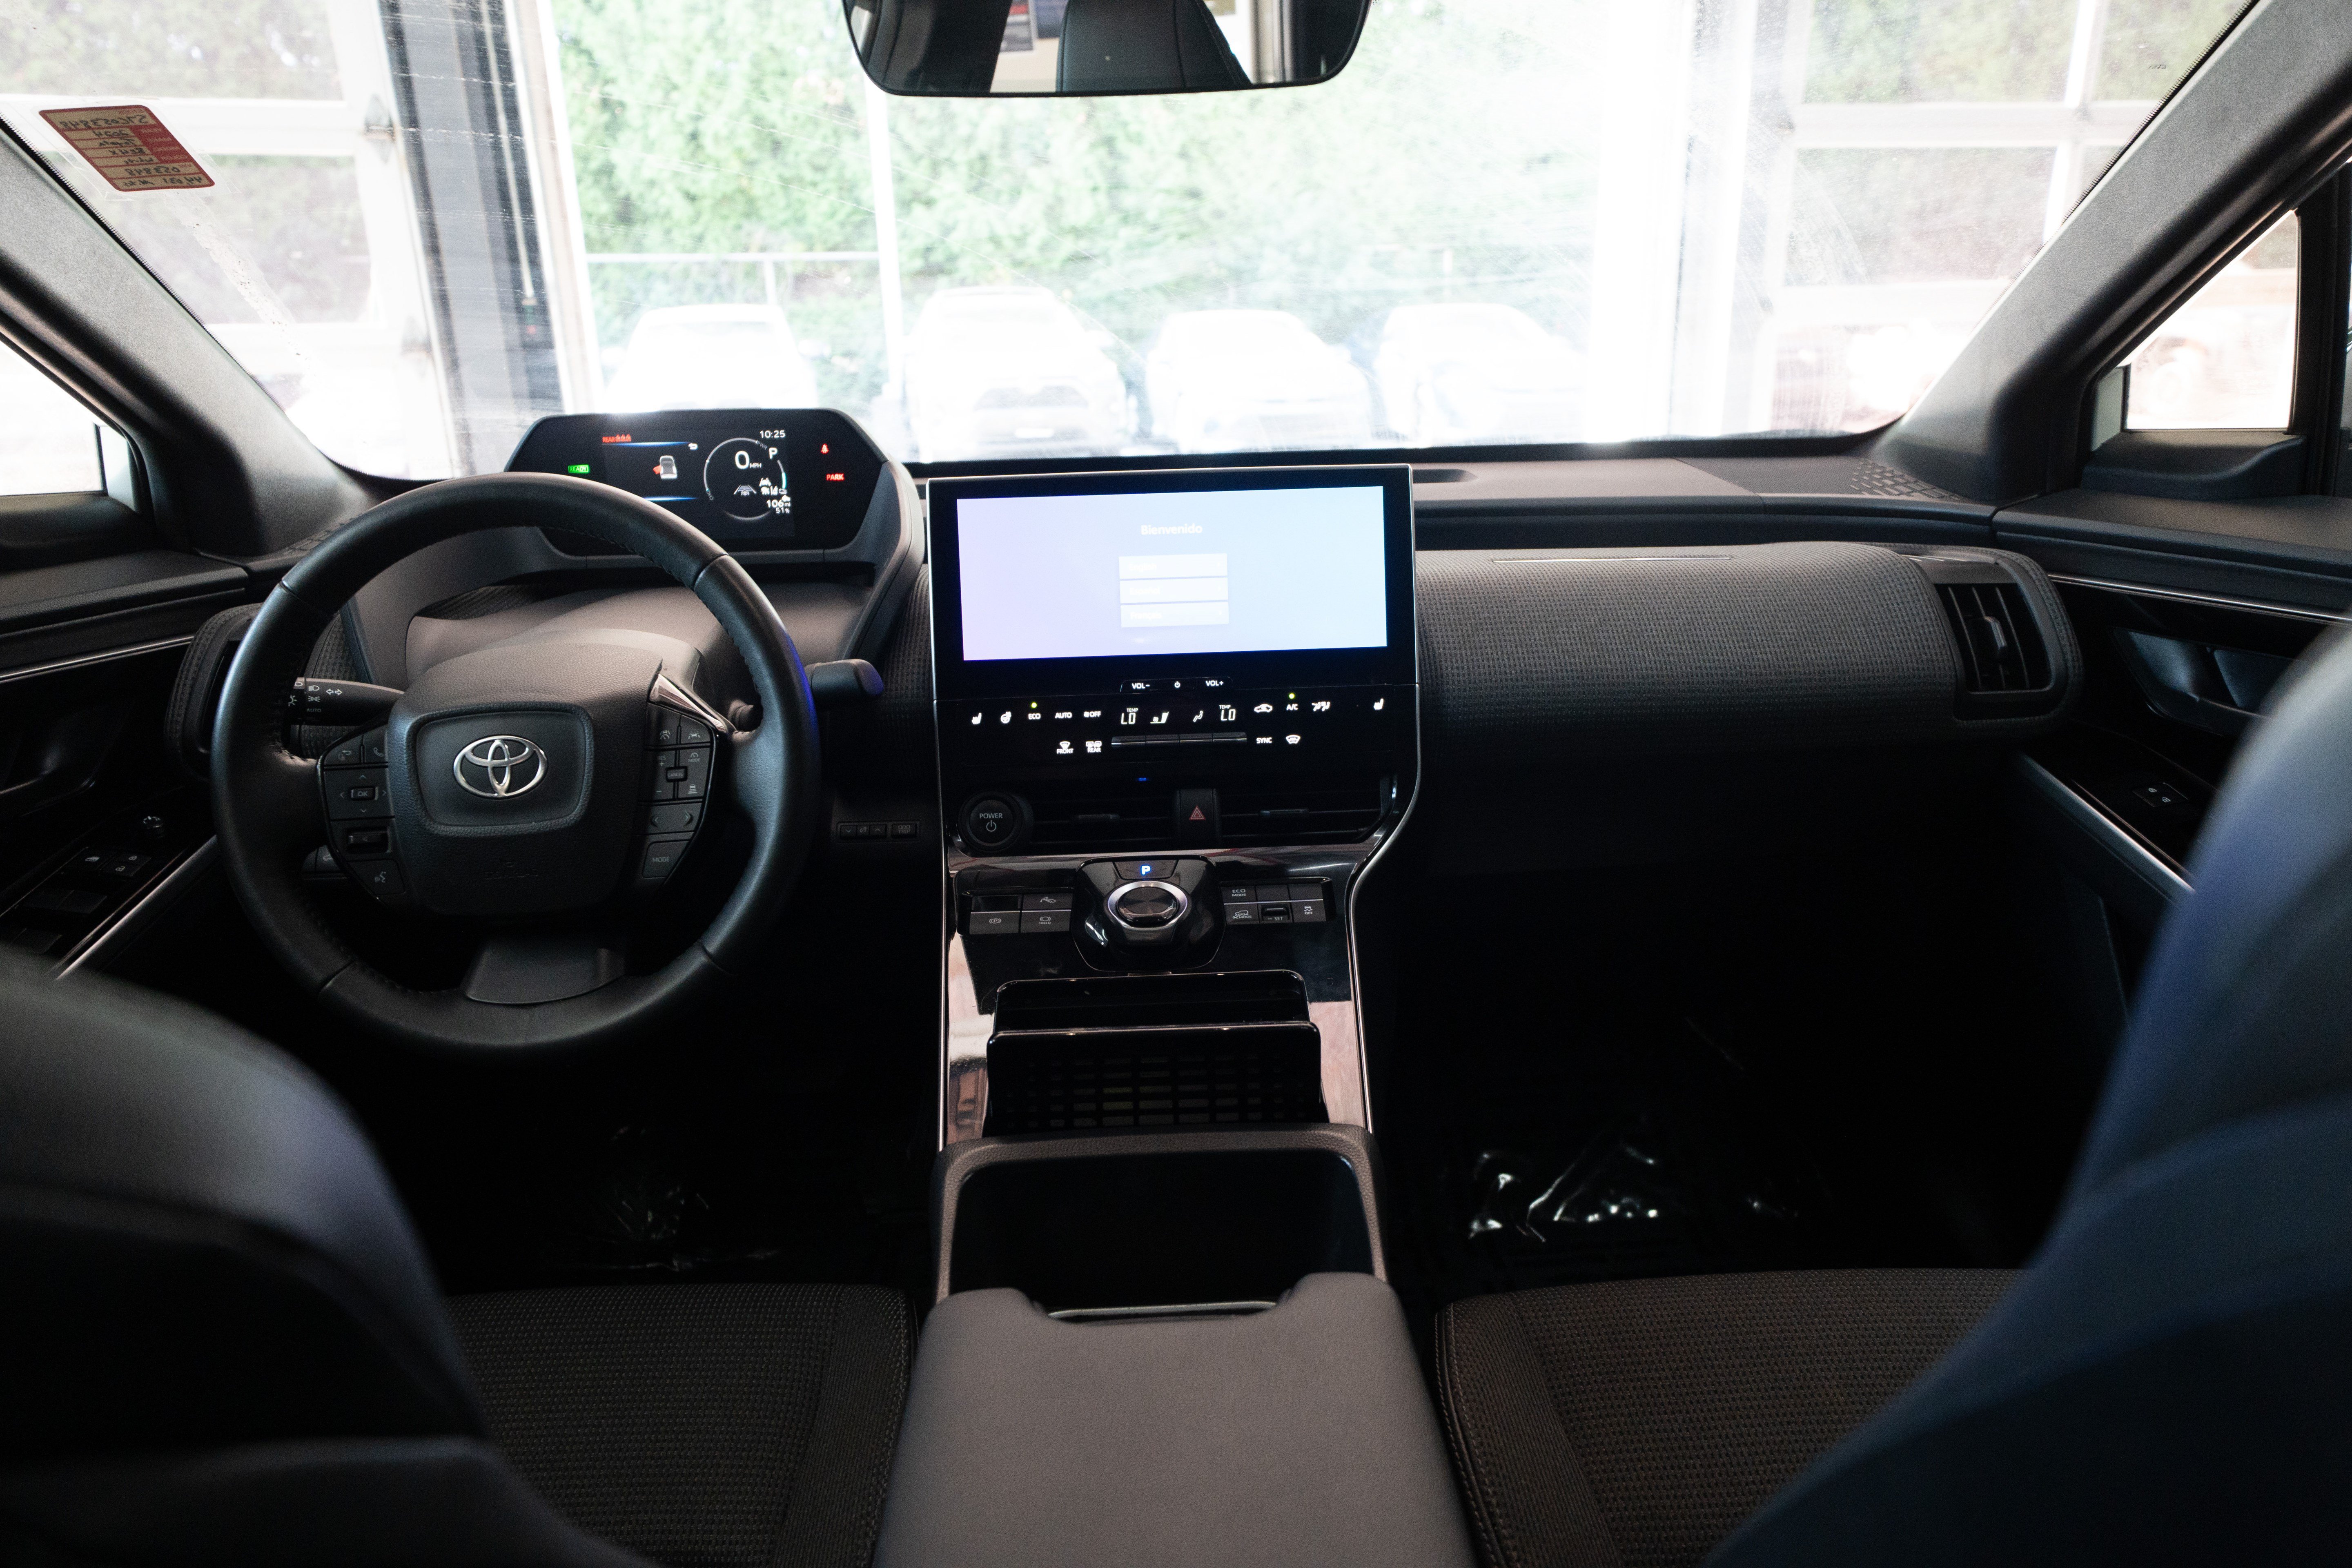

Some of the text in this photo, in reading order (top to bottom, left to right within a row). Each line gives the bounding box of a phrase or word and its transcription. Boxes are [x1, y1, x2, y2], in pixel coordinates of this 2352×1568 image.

[760, 430, 786, 439] 10:25
[757, 440, 768, 450] PWR
[769, 447, 778, 459] P
[735, 450, 750, 469] 0
[826, 473, 845, 481] PARK
[1140, 523, 1203, 535] Bienvenido
[1129, 562, 1157, 572] English
[1121, 713, 1136, 724] LO
[1221, 709, 1236, 721] LO
[1141, 865, 1151, 875] P
